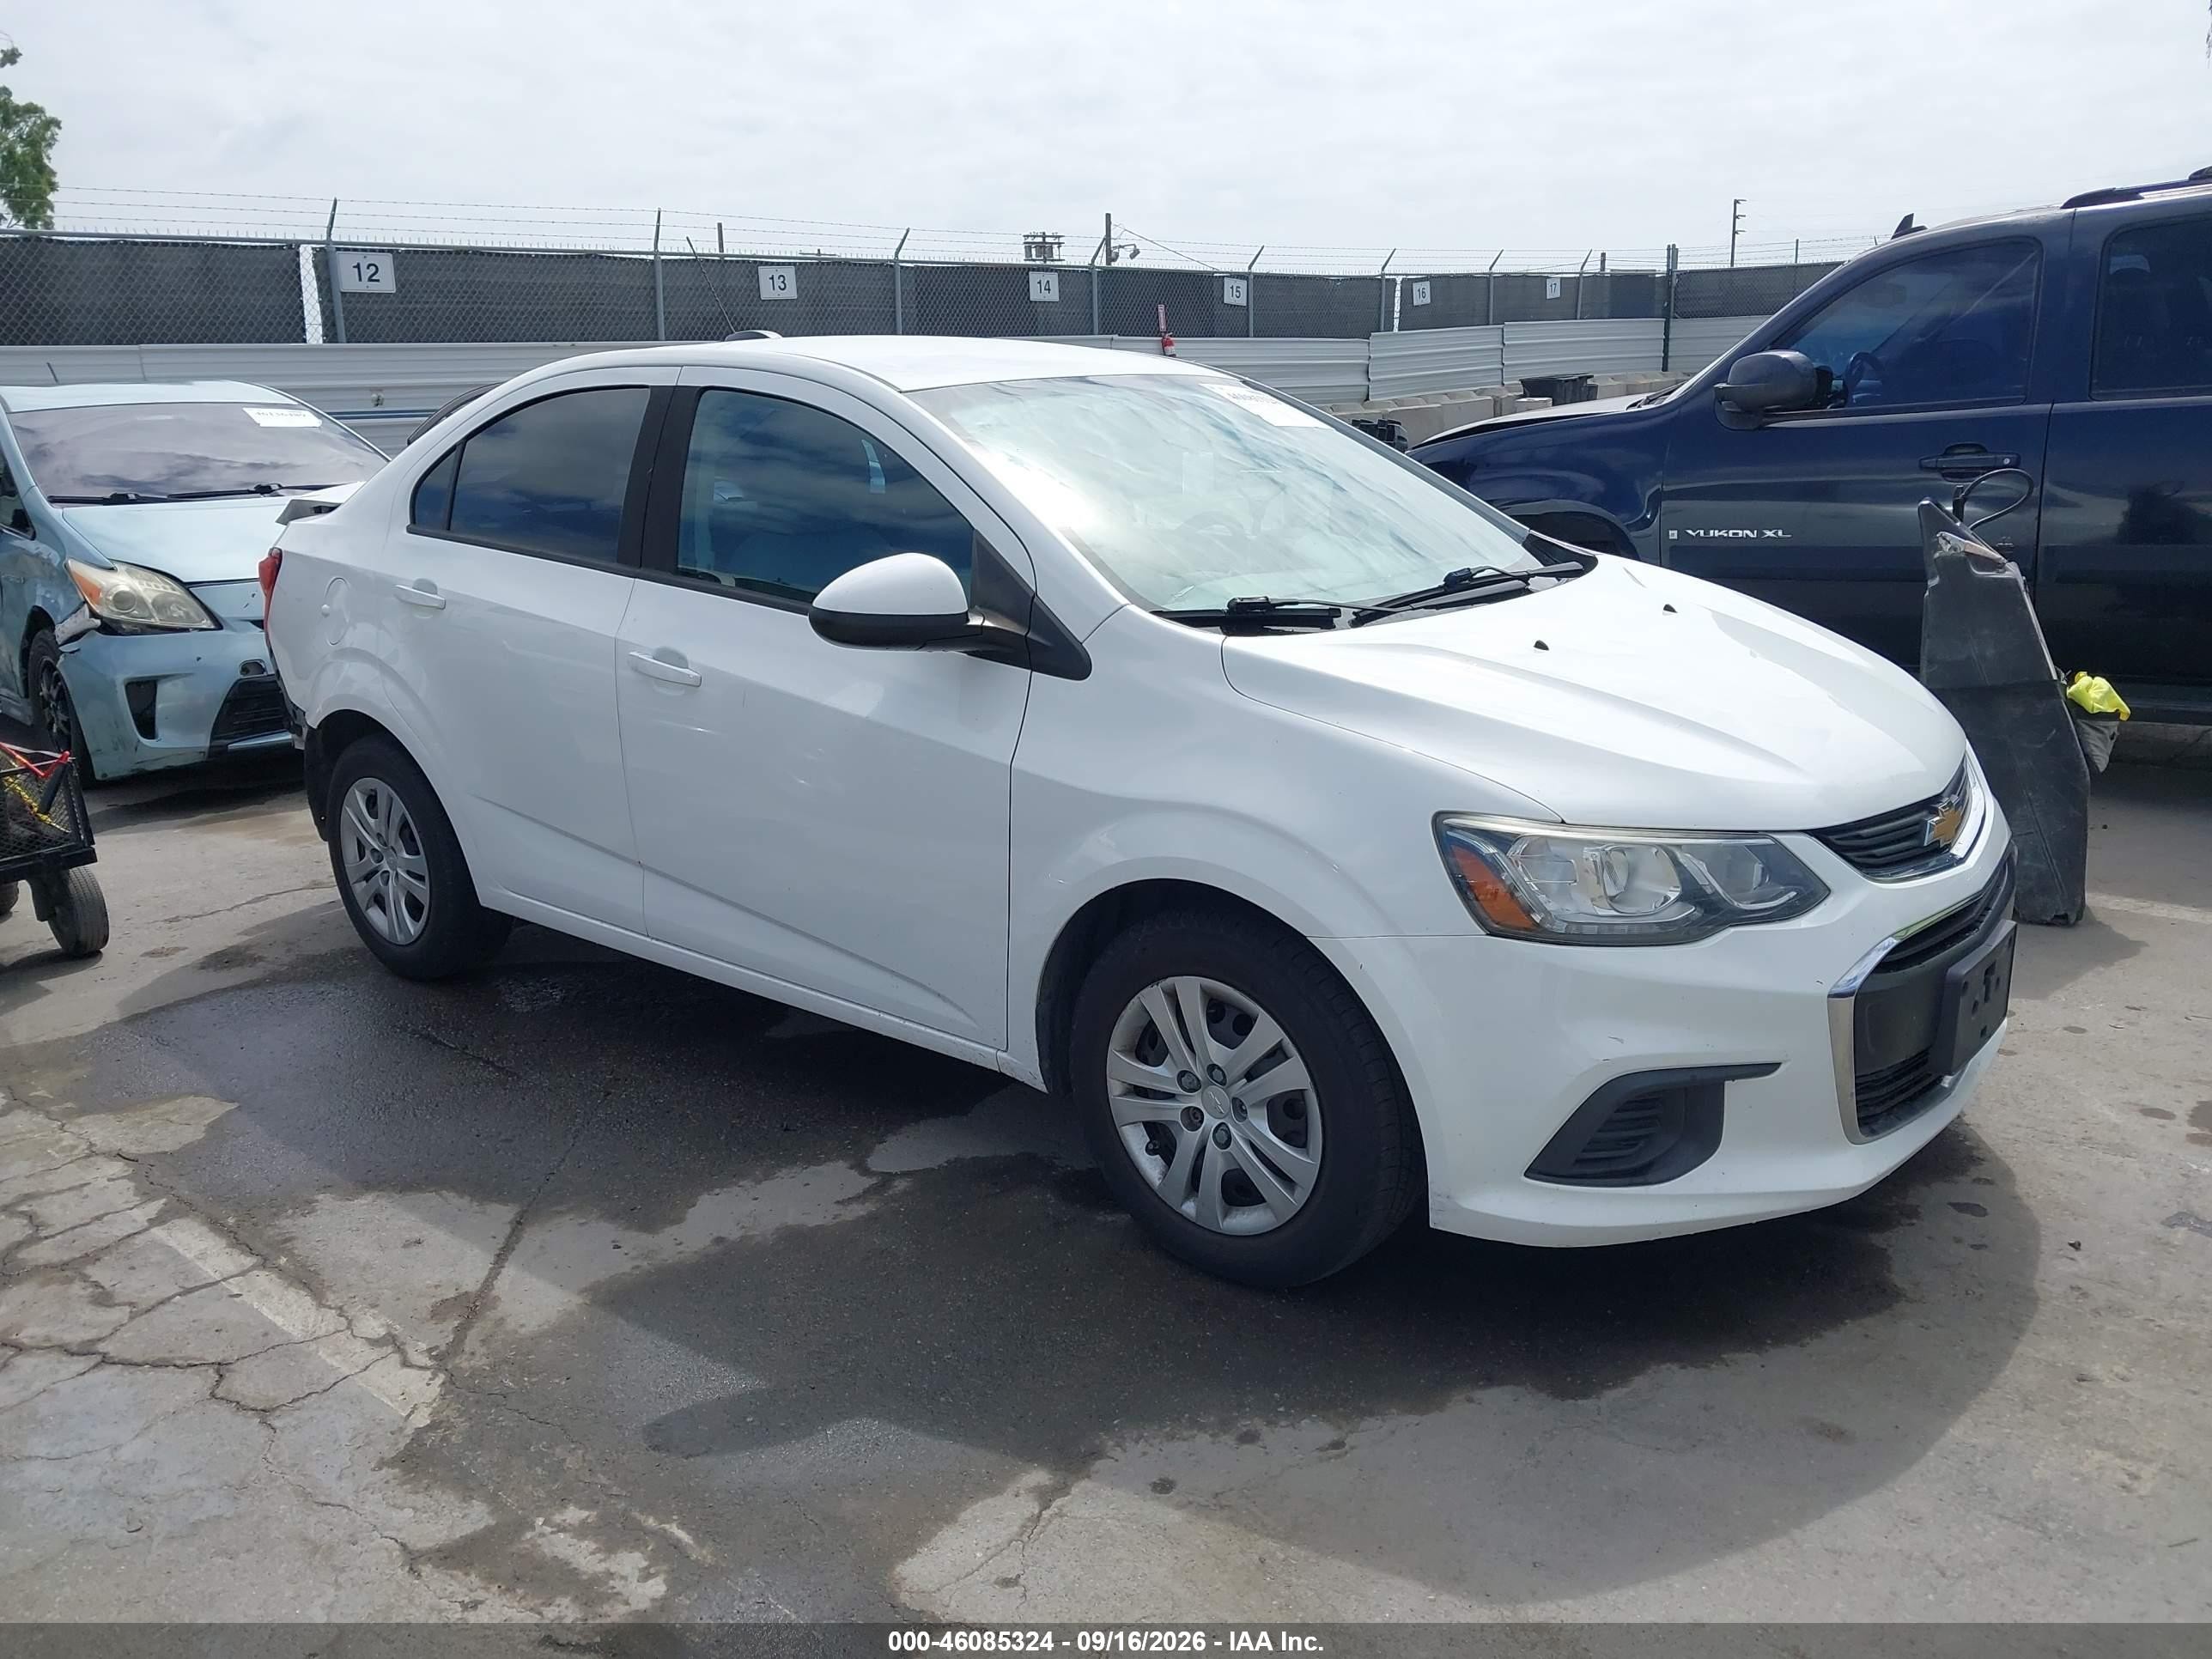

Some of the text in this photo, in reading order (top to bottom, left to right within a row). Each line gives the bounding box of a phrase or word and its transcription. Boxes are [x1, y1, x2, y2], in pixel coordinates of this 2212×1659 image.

[352, 262, 380, 283] 12
[769, 274, 787, 291] 13
[1036, 279, 1052, 294] 14
[1549, 283, 1558, 294] 17
[1229, 285, 1242, 300] 15
[1417, 287, 1427, 300] 16
[1686, 529, 1793, 538] YUKON XL
